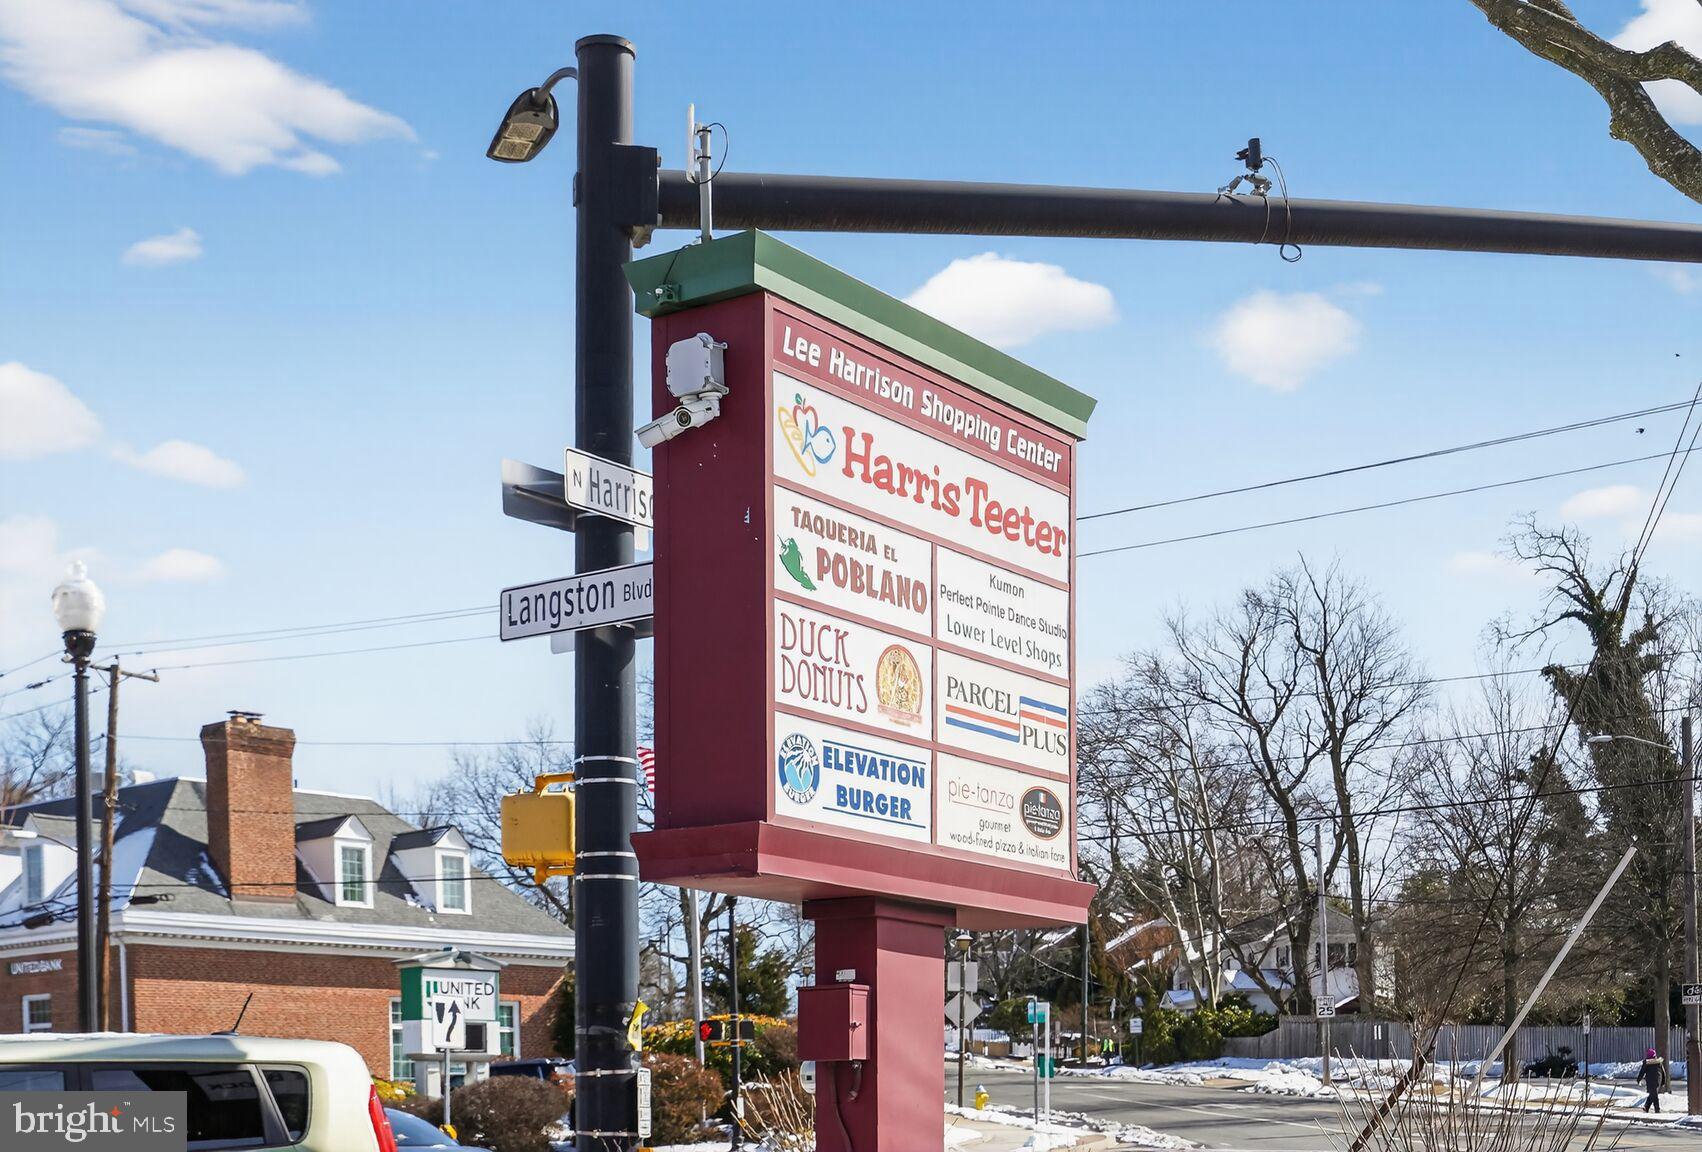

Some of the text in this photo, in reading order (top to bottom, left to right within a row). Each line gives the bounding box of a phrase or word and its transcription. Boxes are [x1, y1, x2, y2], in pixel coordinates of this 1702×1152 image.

[783, 326, 1062, 472] Lee Harrison Shopping Center
[573, 467, 653, 520] N Harris
[841, 426, 1067, 557] Harris Teeter
[791, 506, 898, 563] TAQUERIA EL
[508, 578, 652, 628] Langston Blvd
[816, 547, 928, 615] POBLANO
[989, 573, 1025, 598] Kumon
[940, 584, 1067, 639] Perfect Pointe Dance Studio
[780, 612, 850, 668] DUCK
[947, 613, 1062, 670] Lower Level Shops
[781, 654, 868, 714] DONUTS
[947, 675, 1018, 717] PARCEL
[1022, 724, 1067, 757] PLUS
[823, 745, 926, 789] ELEVATION
[836, 784, 912, 821] BURGER
[948, 777, 1014, 809] pie-tanza
[949, 831, 1065, 862] wood-fired pizza & italian fare
[979, 818, 1011, 833] gourmet
[441, 982, 495, 996] UNITED
[1319, 1006, 1334, 1016] 25
